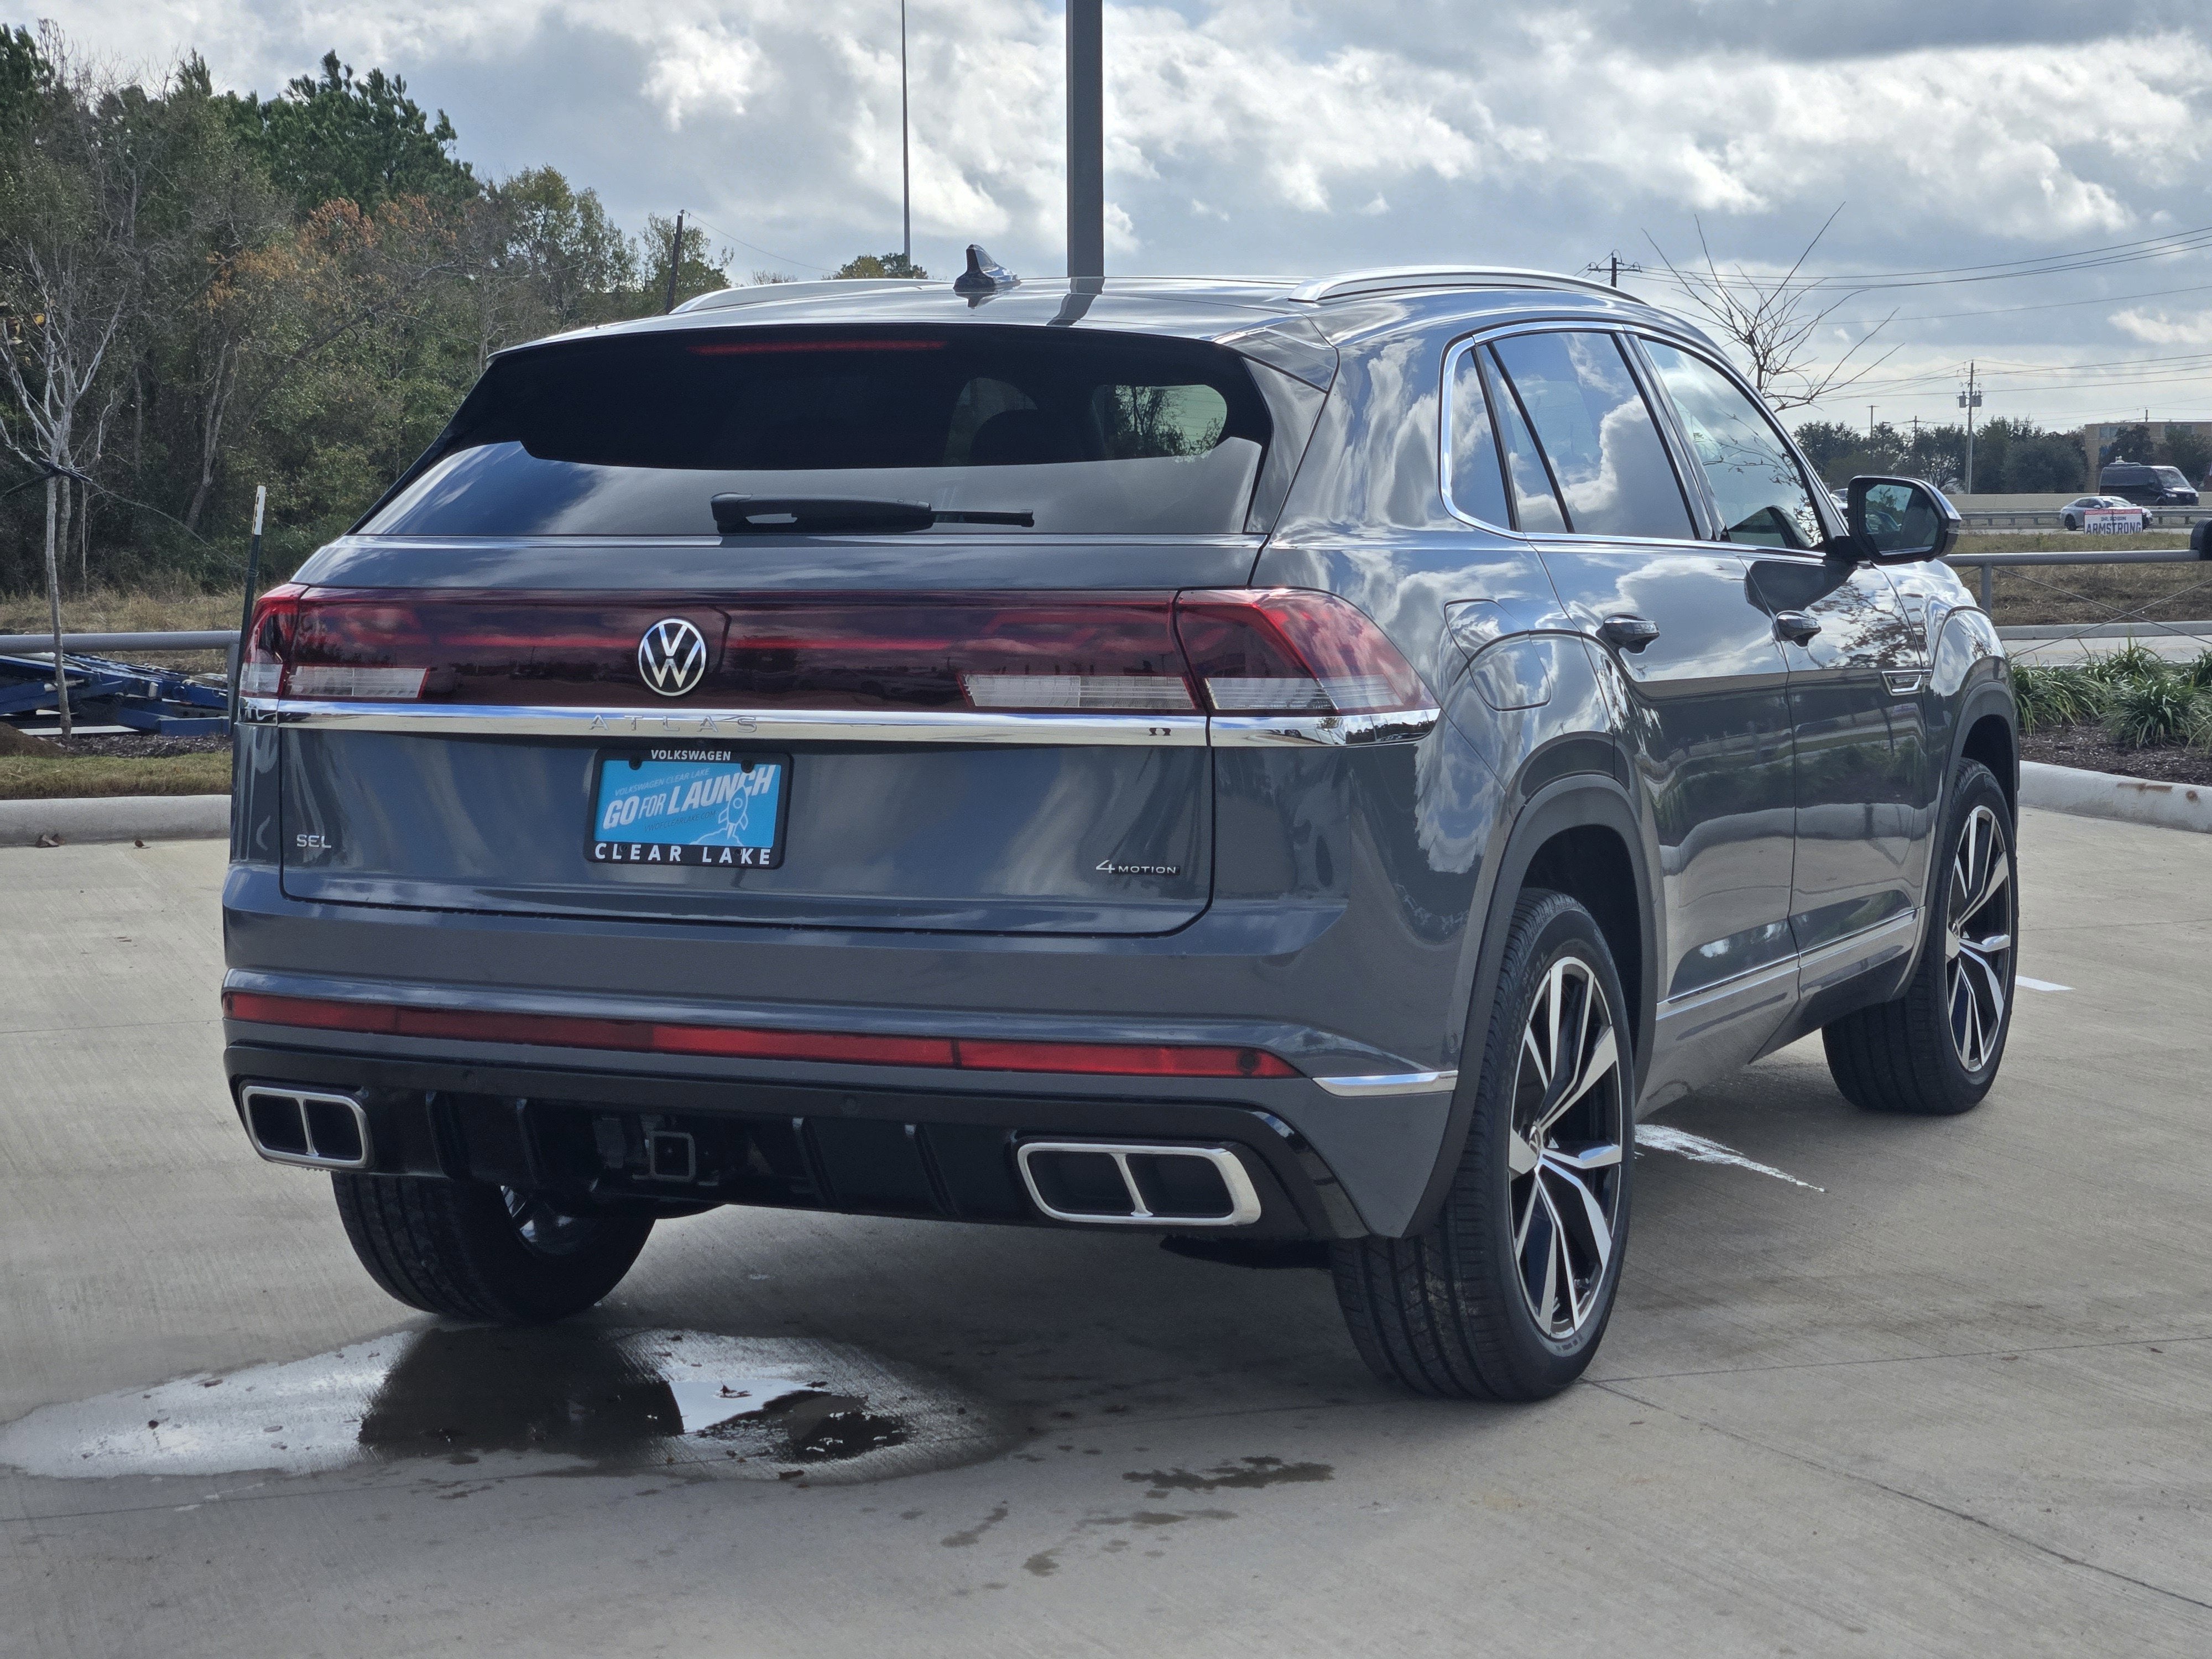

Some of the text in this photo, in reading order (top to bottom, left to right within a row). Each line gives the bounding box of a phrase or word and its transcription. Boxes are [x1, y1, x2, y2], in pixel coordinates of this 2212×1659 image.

[2086, 522, 2141, 535] ARMSTRONG
[589, 714, 758, 733] ATLAS
[650, 749, 732, 761] VOLKSWAGEN
[614, 768, 711, 797] VOLKSWAGEN CLEAR LAKE
[603, 764, 776, 830] GO FOR LAUNCH
[296, 834, 332, 848] SEL
[594, 843, 771, 865] CLEAR LAKE
[1095, 859, 1176, 874] 4MOTION
